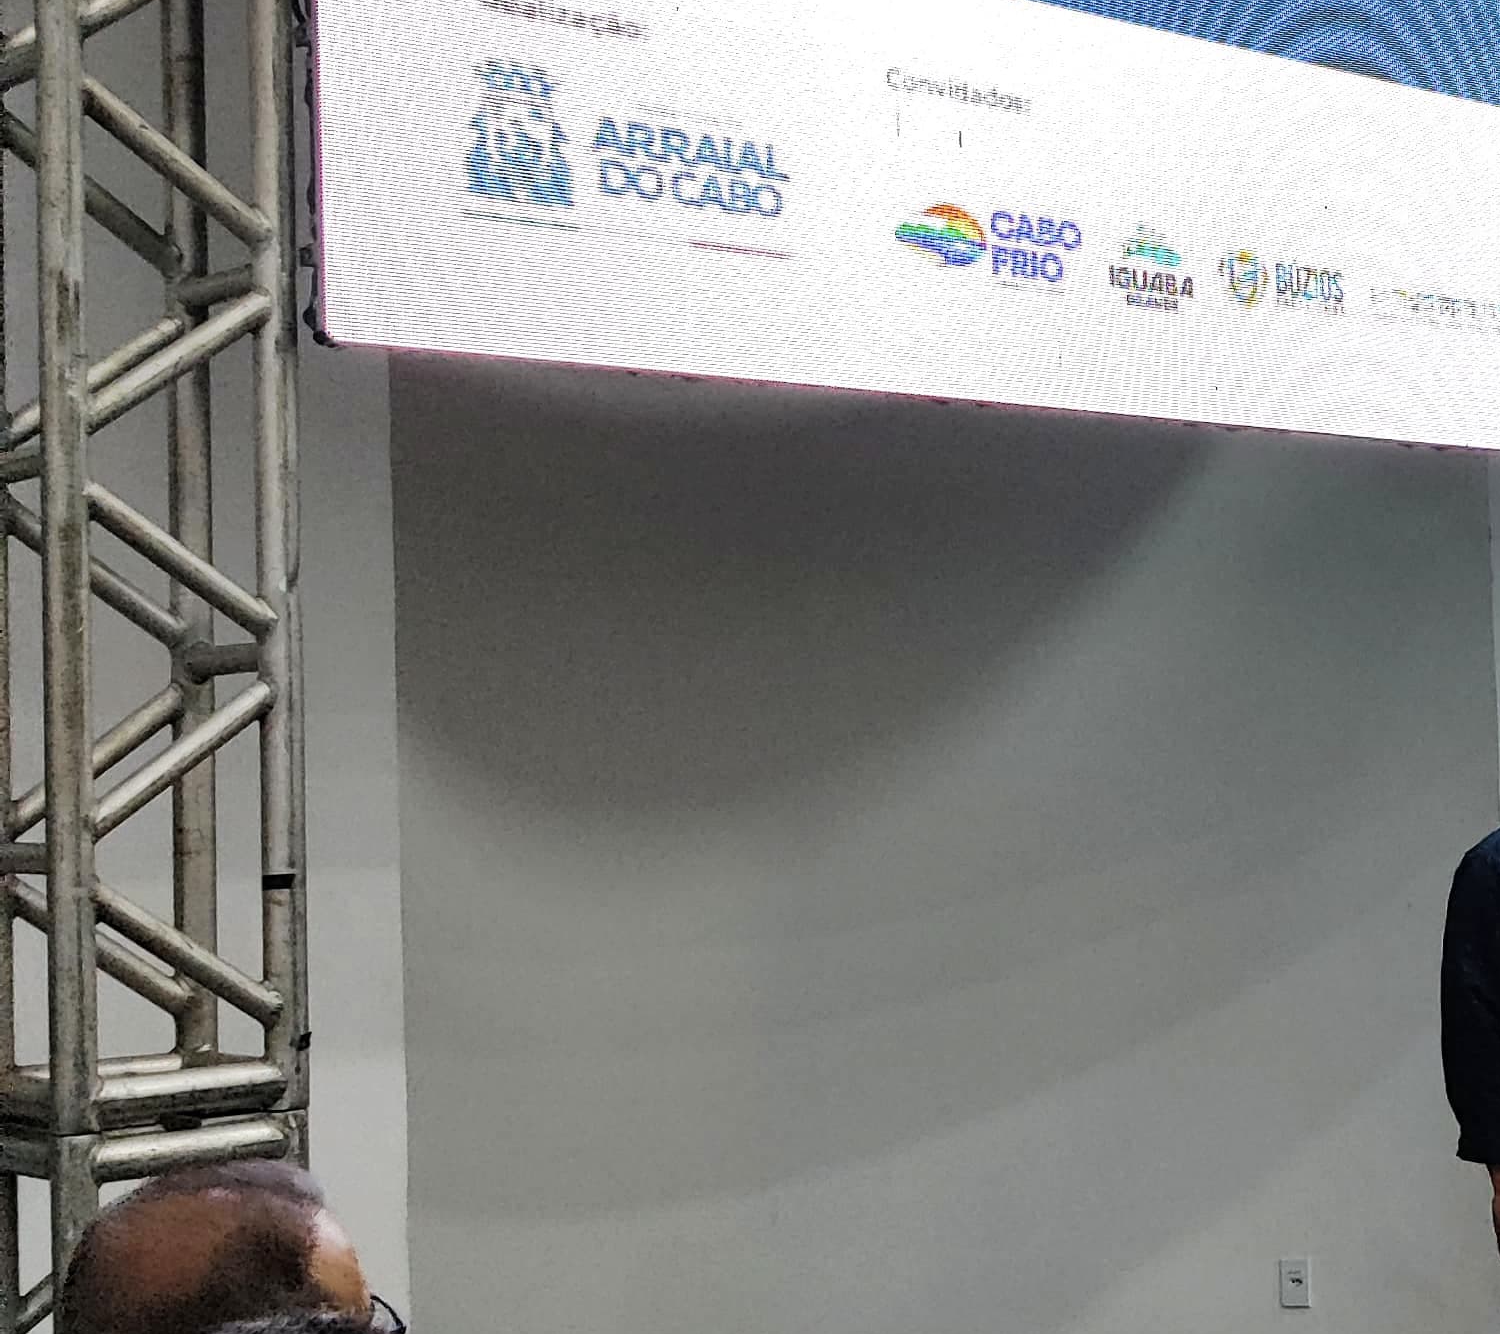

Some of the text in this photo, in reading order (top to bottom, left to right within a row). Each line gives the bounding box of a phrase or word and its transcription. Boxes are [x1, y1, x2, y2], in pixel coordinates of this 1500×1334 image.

[592, 117, 790, 181] ARRAIAL
[599, 160, 782, 217] DO CABO
[990, 210, 1082, 251] CABO
[991, 246, 1063, 283] FRIO
[1109, 264, 1194, 299] IGUABA
